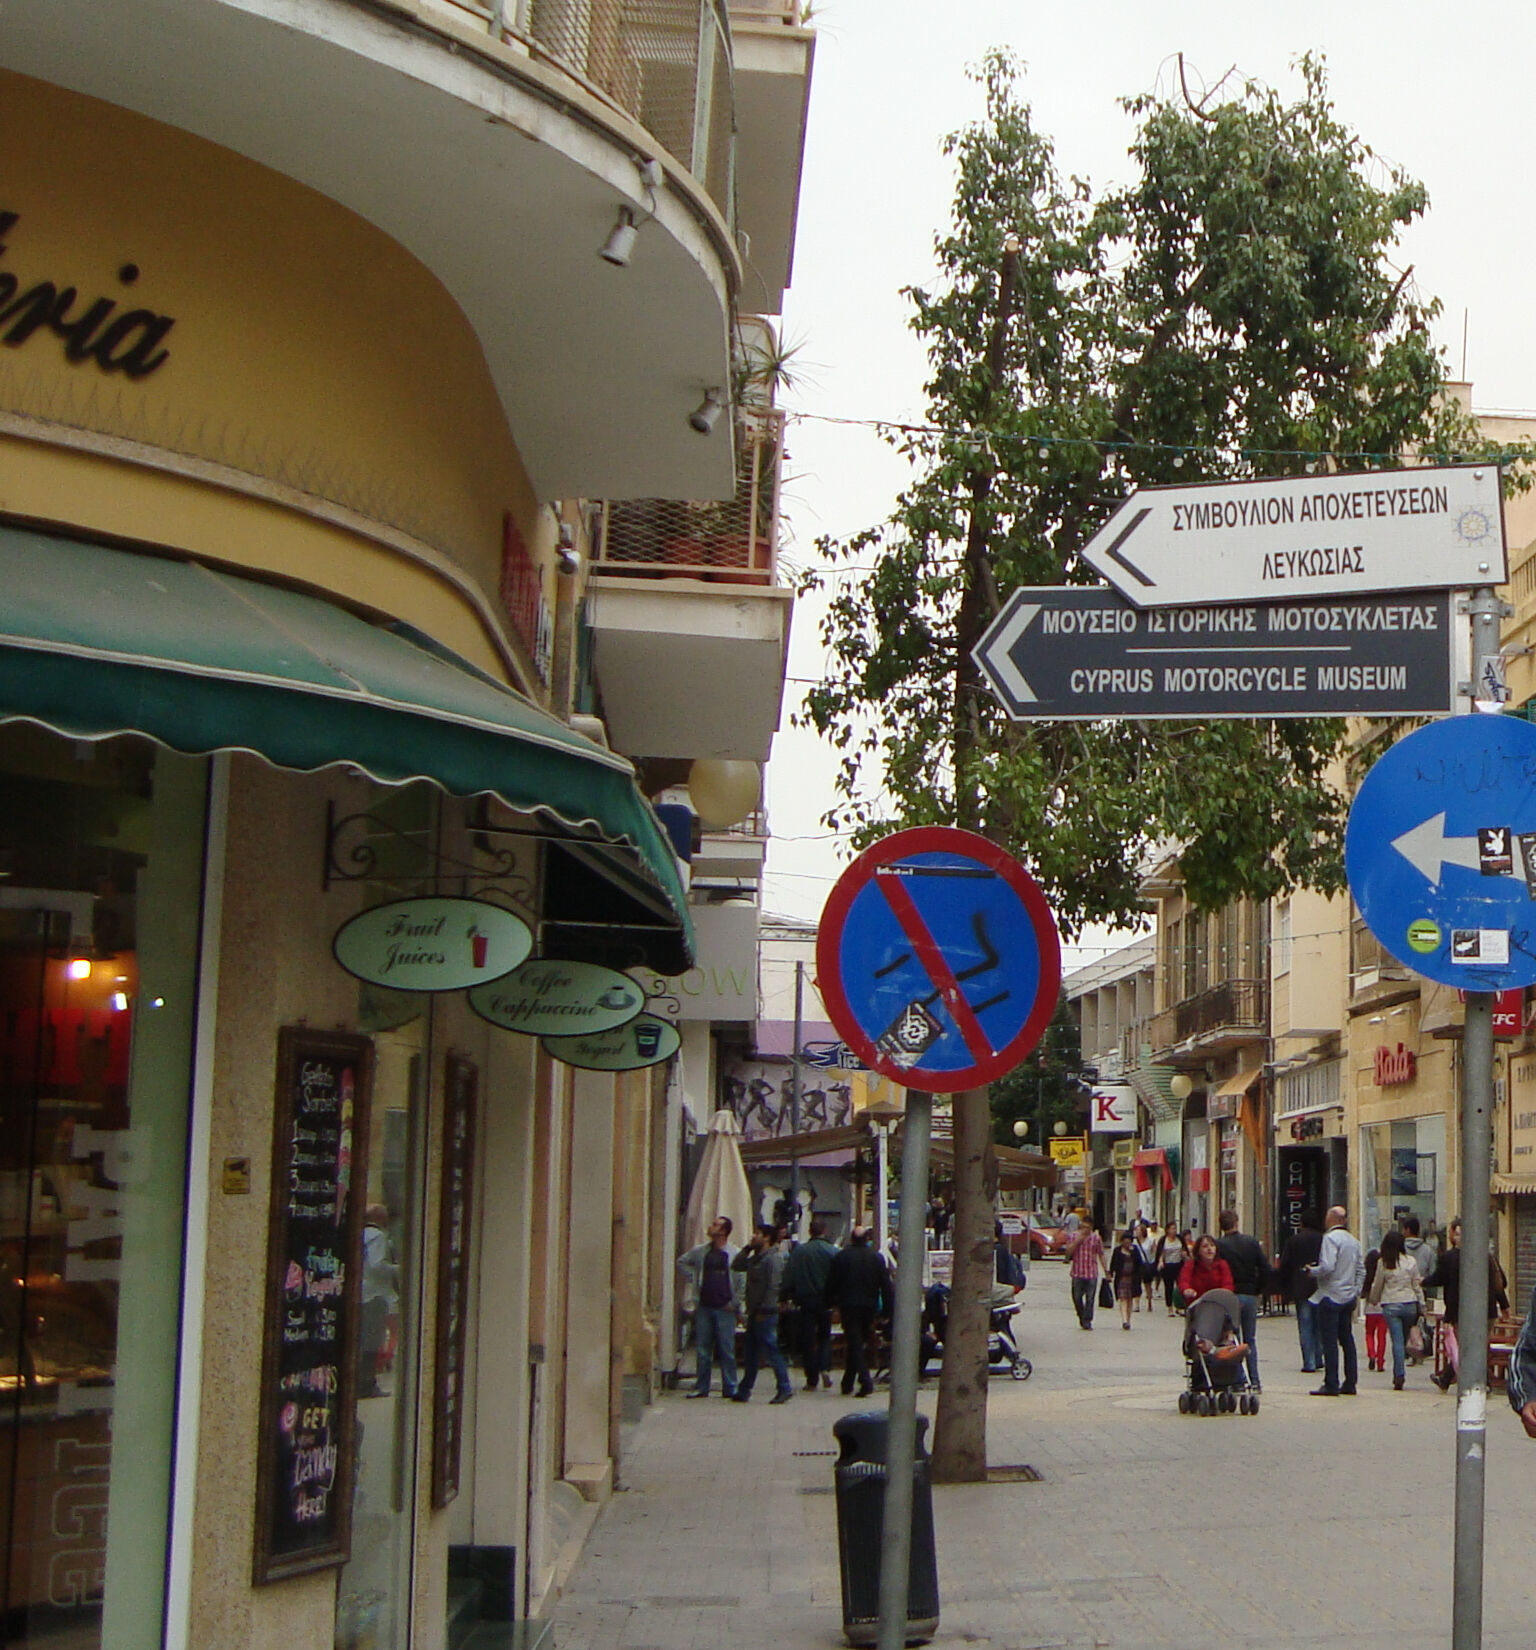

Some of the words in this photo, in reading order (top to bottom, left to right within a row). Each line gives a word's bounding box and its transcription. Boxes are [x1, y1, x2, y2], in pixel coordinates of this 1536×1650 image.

[1172, 496, 1294, 531] ΣΥΜΒΟΥΛΙΟΝ
[1300, 486, 1449, 522] ΑΠΟΧΕΤΕΥΣΕΩΝ
[1262, 546, 1365, 580] ΛΕΥΚΩΣΙΑΣ
[1043, 608, 1137, 634] ΜΟΥΣΕΙΟ
[1147, 607, 1257, 633] ΙΣΤΟΡΙΚΗΣ
[1268, 605, 1437, 632] ΜΟΤΟΣΥΚΛΕΤΑΣ
[1070, 668, 1153, 693] CYPRUS
[1164, 667, 1307, 692] MOTORCYCLE
[1317, 665, 1407, 691] MUSEUM
[386, 913, 446, 937] Fruit
[377, 942, 446, 974] Juices
[519, 967, 573, 995] Coffee
[1091, 1096, 1123, 1121] K
[302, 1407, 331, 1430] GET
